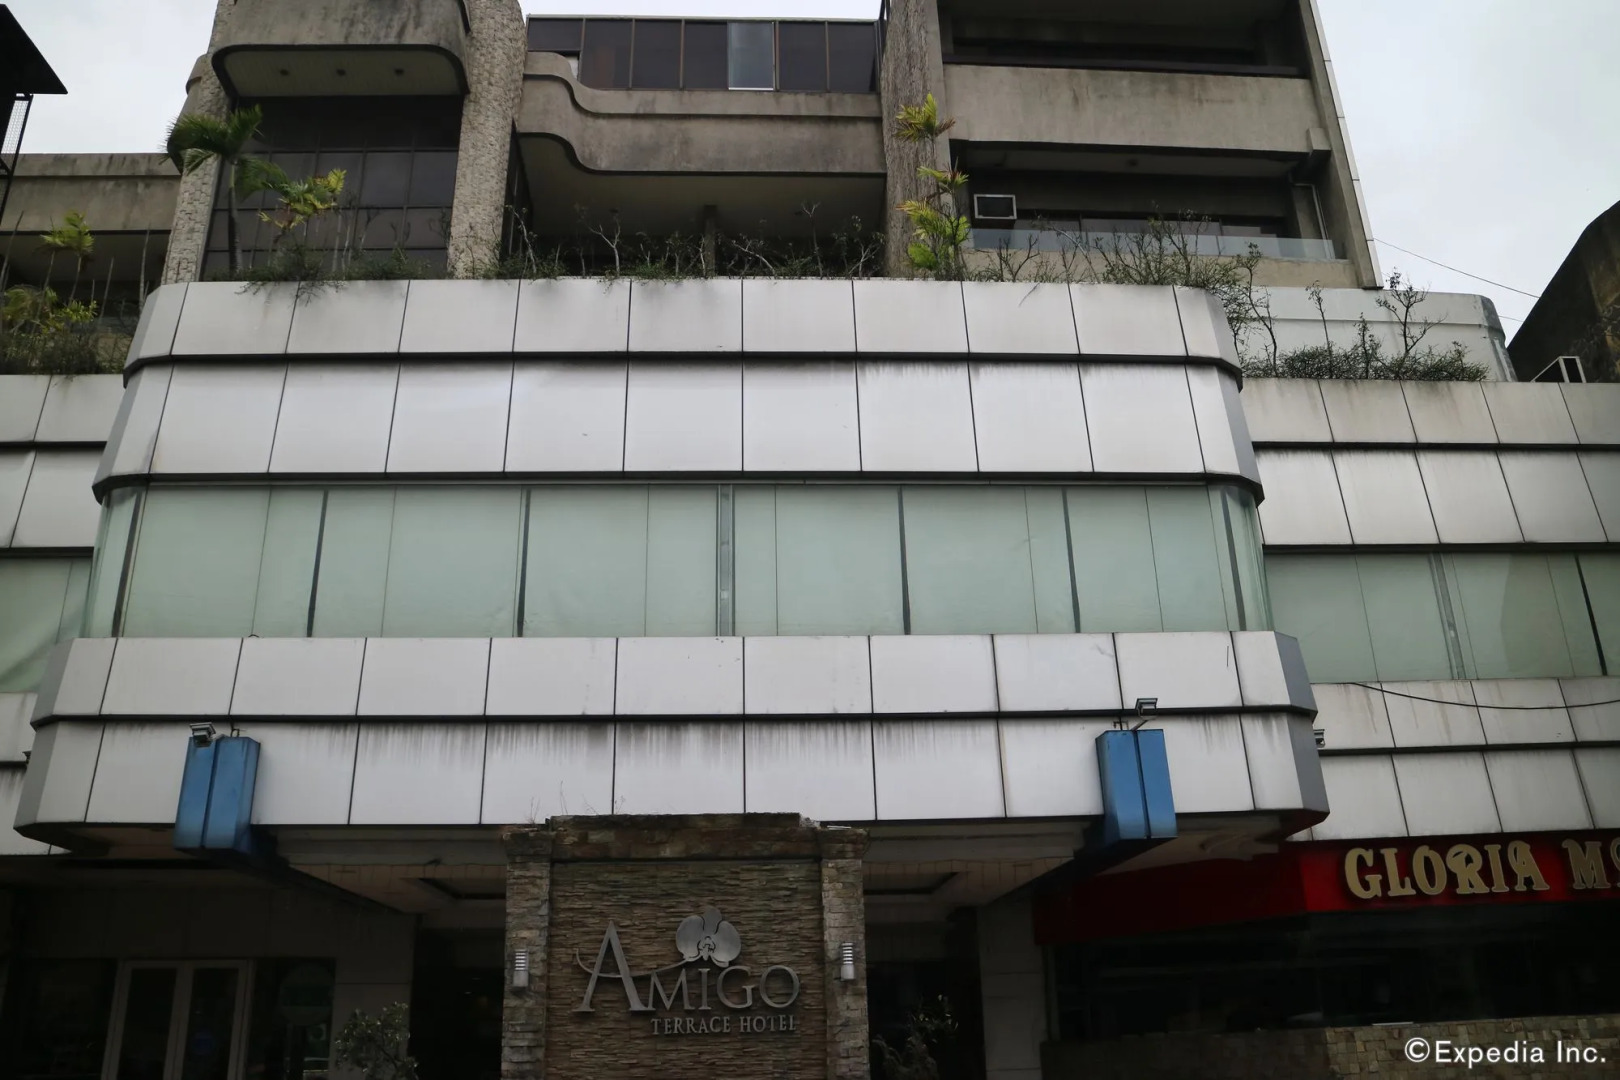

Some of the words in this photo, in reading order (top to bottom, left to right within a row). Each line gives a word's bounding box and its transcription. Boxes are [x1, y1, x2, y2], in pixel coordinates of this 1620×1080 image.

[1345, 840, 1550, 899] GLORIA
[1562, 838, 1620, 890] M
[651, 1017, 731, 1035] TERRACE
[739, 1014, 797, 1033] HOTEL
